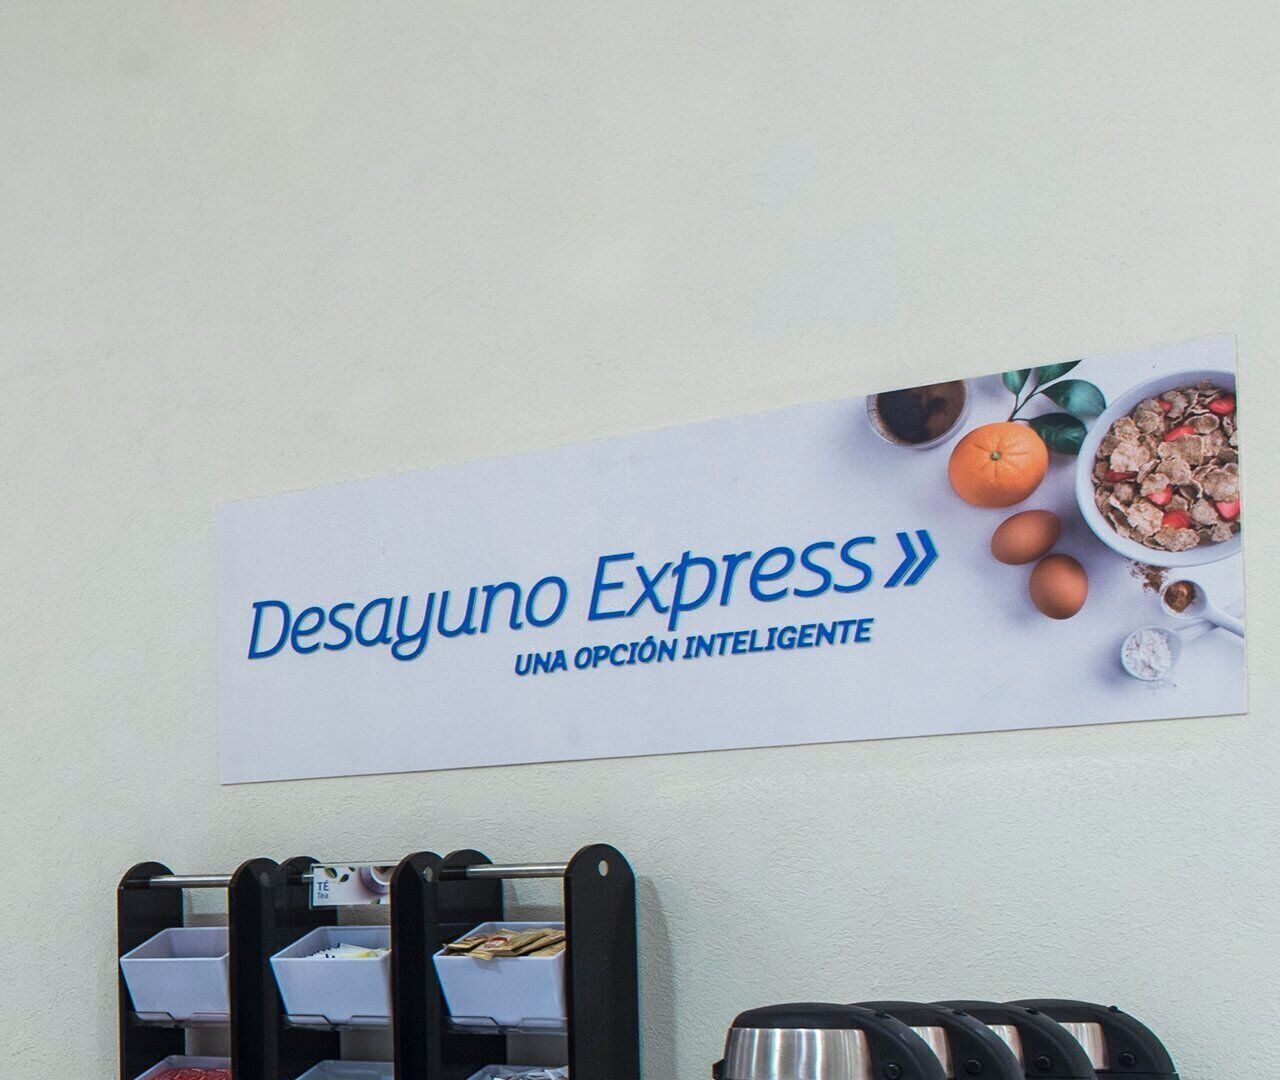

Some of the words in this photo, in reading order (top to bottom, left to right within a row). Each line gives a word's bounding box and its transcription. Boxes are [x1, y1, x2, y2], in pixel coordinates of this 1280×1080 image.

[247, 575, 568, 662] Desayuno
[587, 535, 877, 632] Express
[514, 649, 568, 677] UNA
[574, 635, 678, 669] OPCIÓN
[682, 617, 875, 659] INTELIGENTE
[316, 880, 329, 891] TÉ
